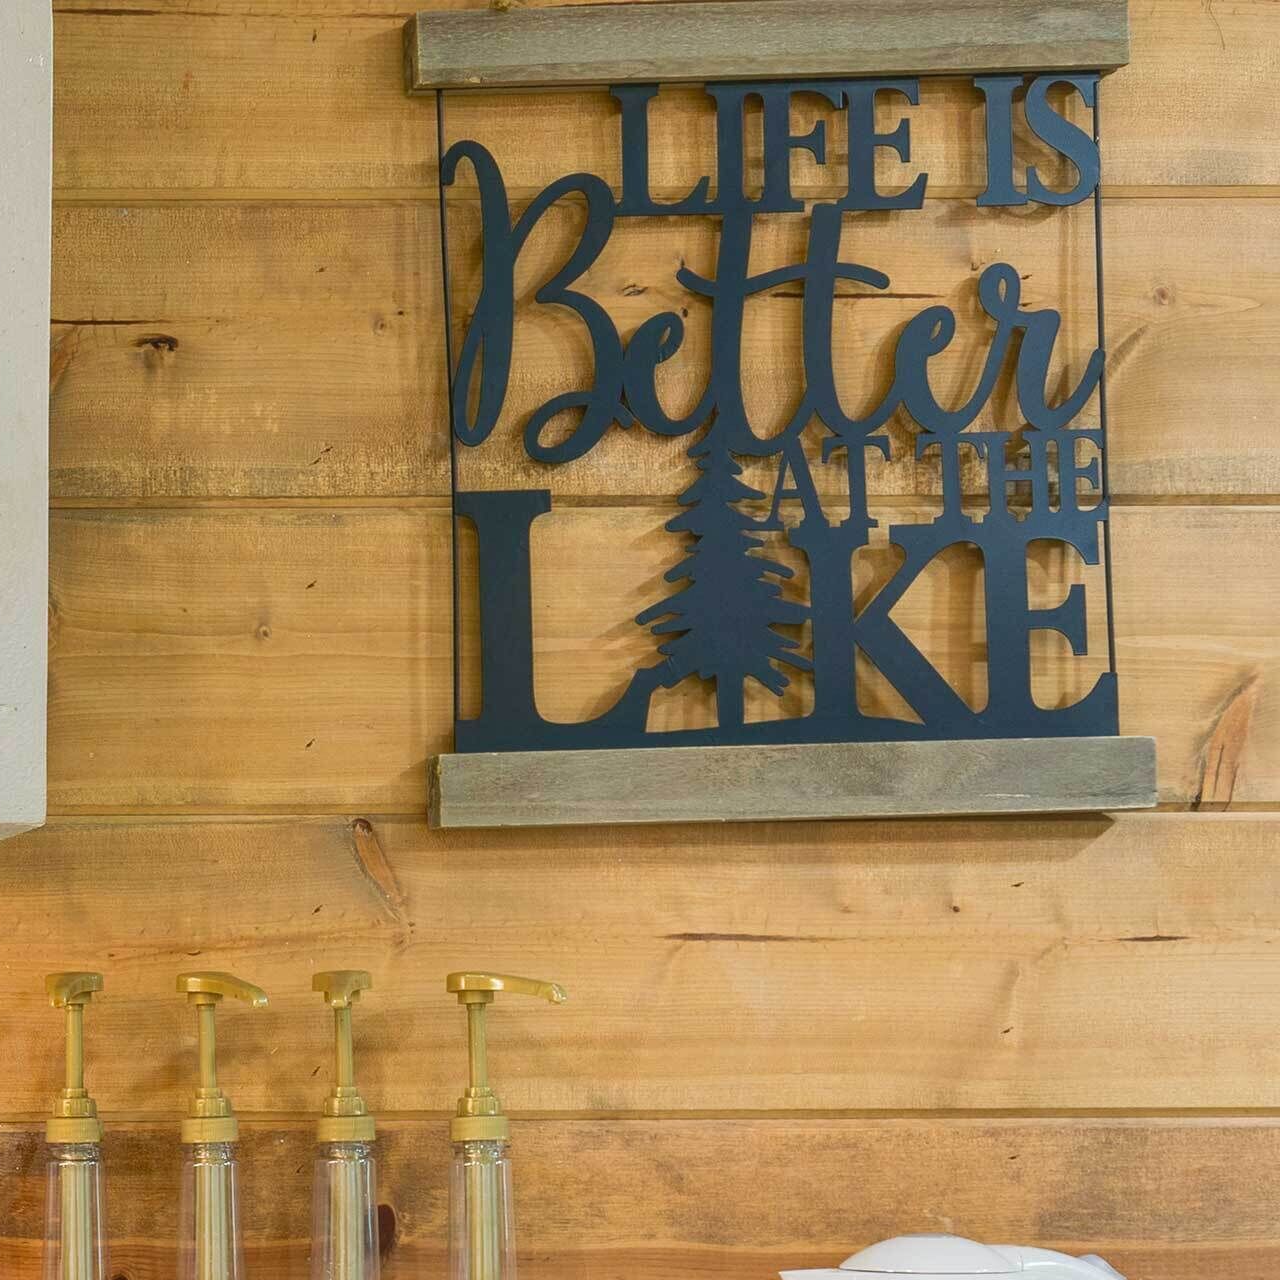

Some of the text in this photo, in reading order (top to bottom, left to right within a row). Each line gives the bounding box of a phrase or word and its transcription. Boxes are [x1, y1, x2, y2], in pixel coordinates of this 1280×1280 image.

[609, 73, 1102, 216] LIFE IS
[441, 139, 1106, 464] Better
[762, 428, 1109, 530] AT THE
